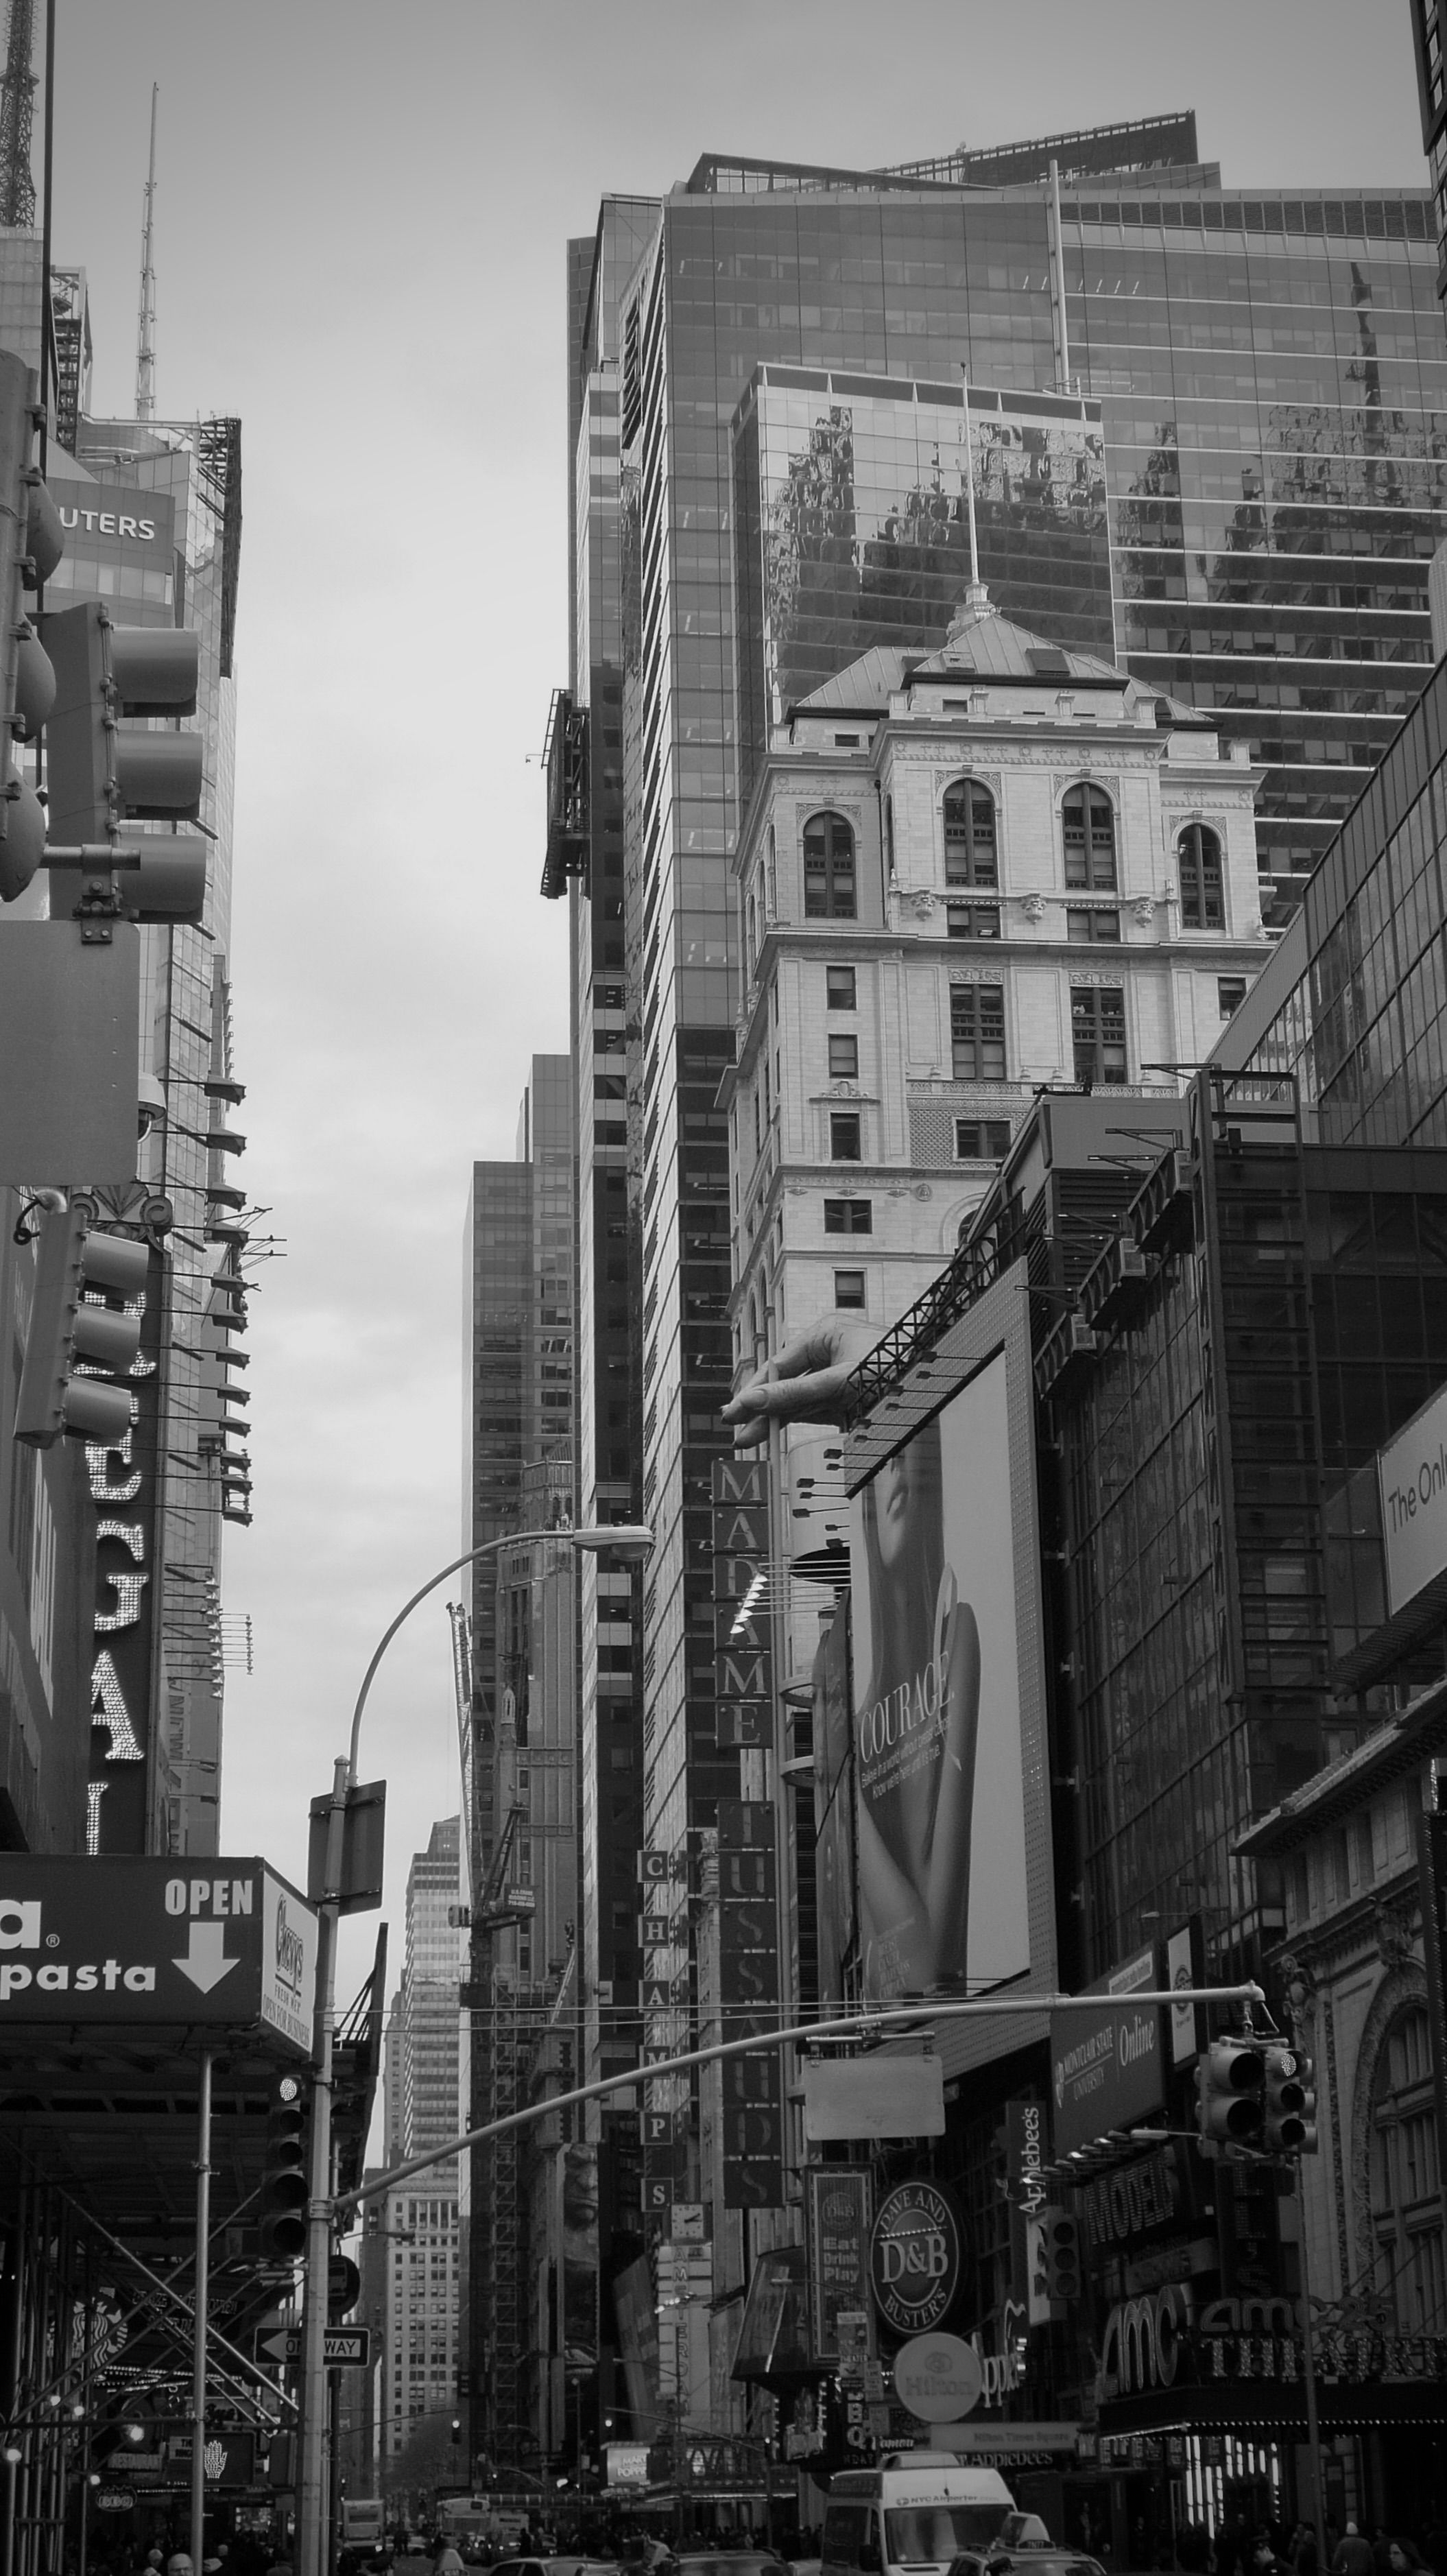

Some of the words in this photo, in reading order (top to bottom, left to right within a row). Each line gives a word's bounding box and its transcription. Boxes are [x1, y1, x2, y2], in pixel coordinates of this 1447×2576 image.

[1389, 1486, 1417, 1534] The
[719, 1464, 767, 1745] MADAME
[861, 1651, 955, 1763] COURAGE.
[164, 1879, 254, 1916] OPEN
[0, 1959, 156, 2001] pasta
[274, 1983, 289, 2006] FRESH
[263, 1993, 276, 2023] OPEN
[276, 2004, 287, 2031] FOR
[287, 2012, 310, 2049] BUSINESS
[728, 1805, 773, 2204] TUSSAUDS
[646, 1856, 667, 2204] CHAMPS
[1097, 2024, 1114, 2057] STATE
[1119, 2014, 1155, 2067] Online
[880, 2191, 911, 2232] DAVE
[916, 2189, 946, 2225] AND
[823, 2237, 859, 2251] Eat
[823, 2252, 859, 2265] Drink
[880, 2232, 949, 2285] D&B
[824, 2267, 860, 2284] Play
[885, 2288, 948, 2328] BUSTER'S
[285, 2338, 302, 2355] ON
[324, 2338, 357, 2356] WAY
[905, 2376, 974, 2397] Hilton
[933, 2494, 978, 2504] Airporter
